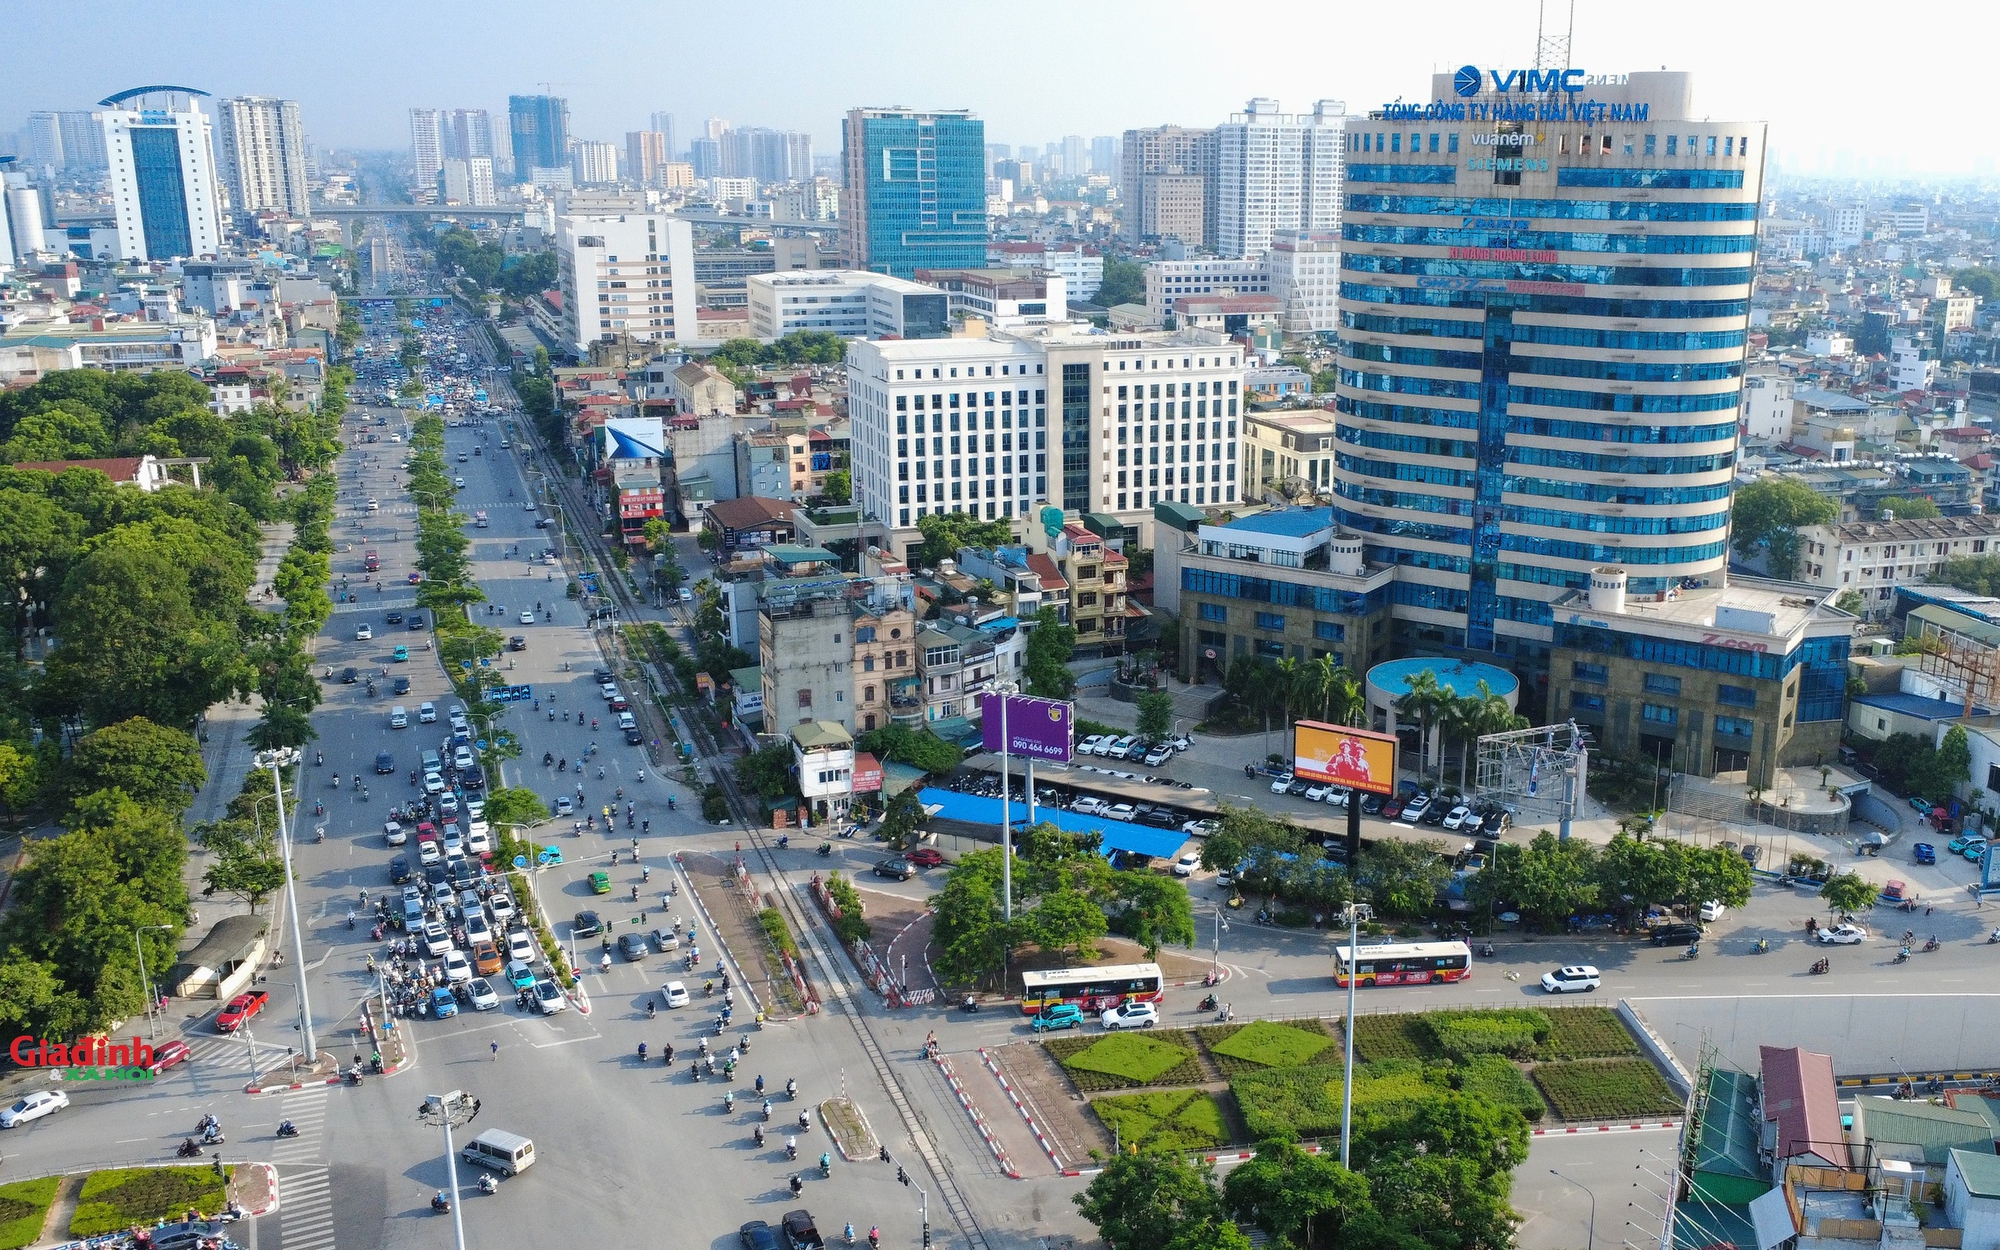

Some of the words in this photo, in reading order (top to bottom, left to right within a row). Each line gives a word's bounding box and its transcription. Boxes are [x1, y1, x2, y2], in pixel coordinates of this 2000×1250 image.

[1489, 69, 1584, 92] VIMC
[1383, 95, 1421, 120] TỔNG
[1425, 98, 1465, 121] CÔNG
[1469, 103, 1489, 120] TY
[1492, 98, 1536, 121] HÀNG
[1540, 97, 1567, 121] HẢI
[1570, 98, 1607, 127] VIỆT
[1611, 103, 1649, 121] NAM
[1467, 157, 1549, 172] SIEMENS
[1531, 251, 1558, 263] LONG
[1702, 633, 1768, 653] Z.com
[1013, 740, 1027, 750] 090
[1028, 744, 1042, 753] 464
[1044, 745, 1063, 756] 6699
